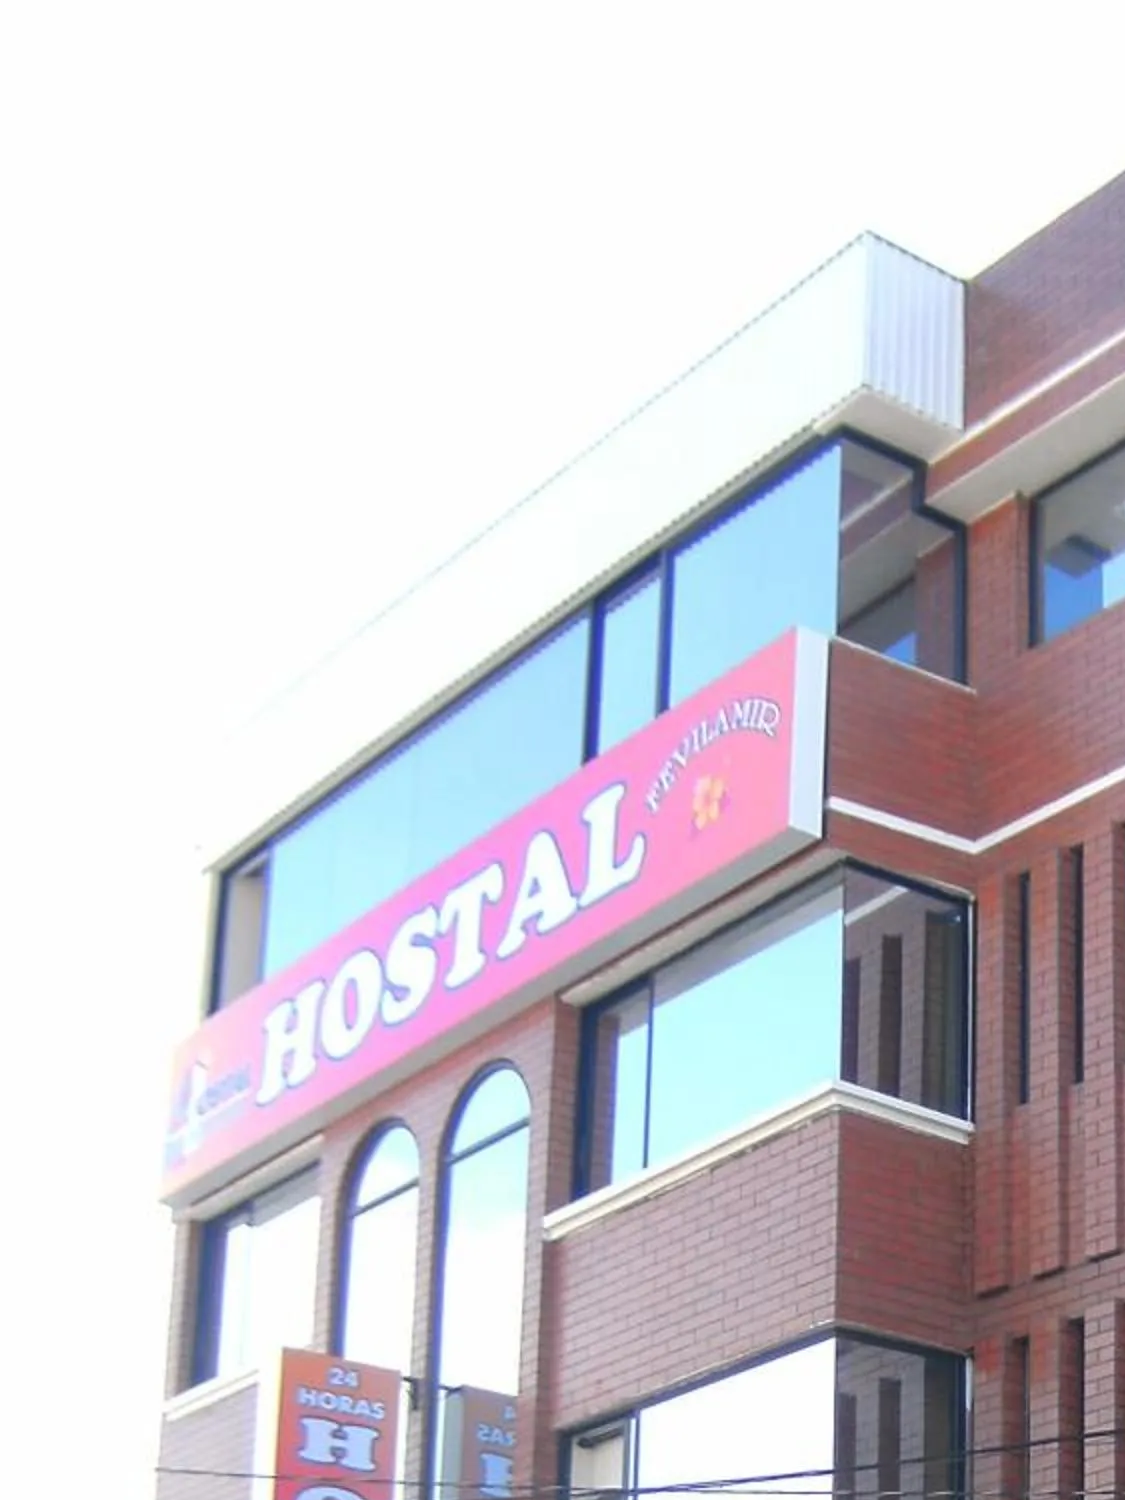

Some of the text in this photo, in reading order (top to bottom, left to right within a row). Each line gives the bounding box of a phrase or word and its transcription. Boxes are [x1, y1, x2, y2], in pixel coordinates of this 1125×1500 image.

[255, 780, 647, 1108] HOSTAL
[327, 1367, 359, 1387] 24
[296, 1386, 386, 1420] HORAS
